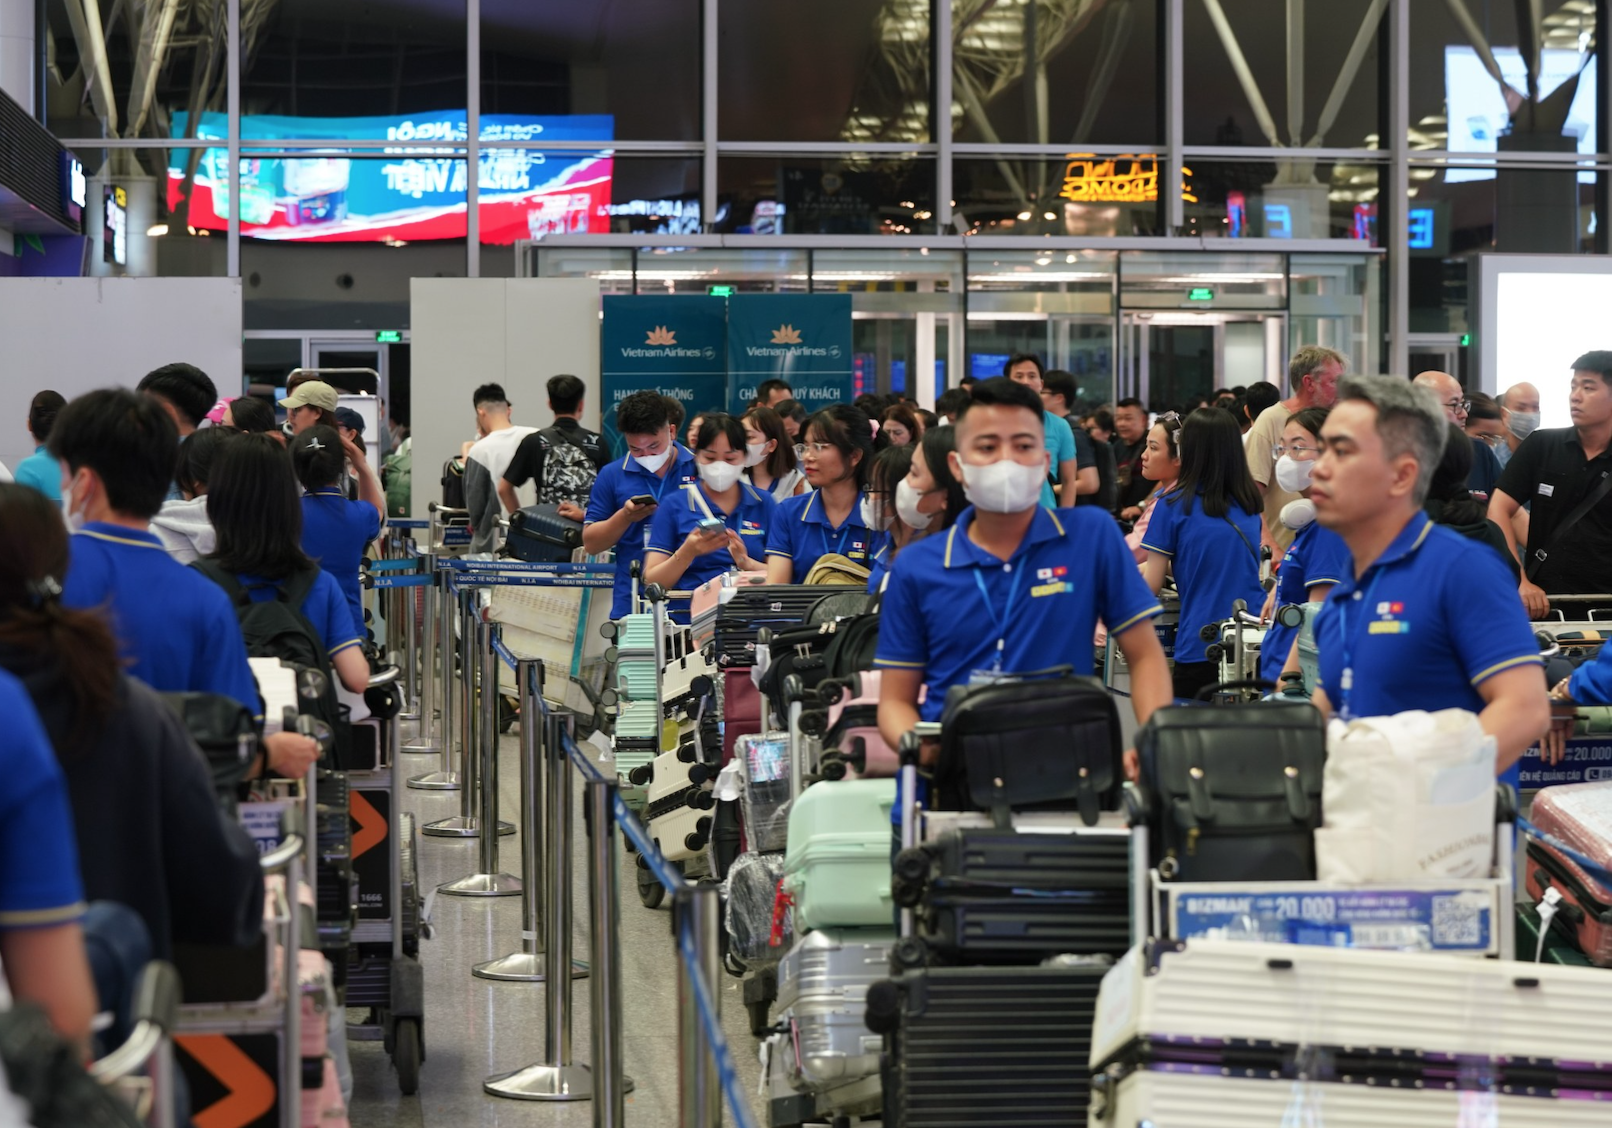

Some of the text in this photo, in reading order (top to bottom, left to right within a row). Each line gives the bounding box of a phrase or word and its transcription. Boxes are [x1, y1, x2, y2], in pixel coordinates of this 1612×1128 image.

[621, 347, 701, 358] Vietnam Airlines
[746, 346, 827, 357] Vietnam Airlines
[809, 386, 841, 400] KHÁCH
[361, 893, 383, 902] 1666
[1275, 896, 1336, 920] 20.000
